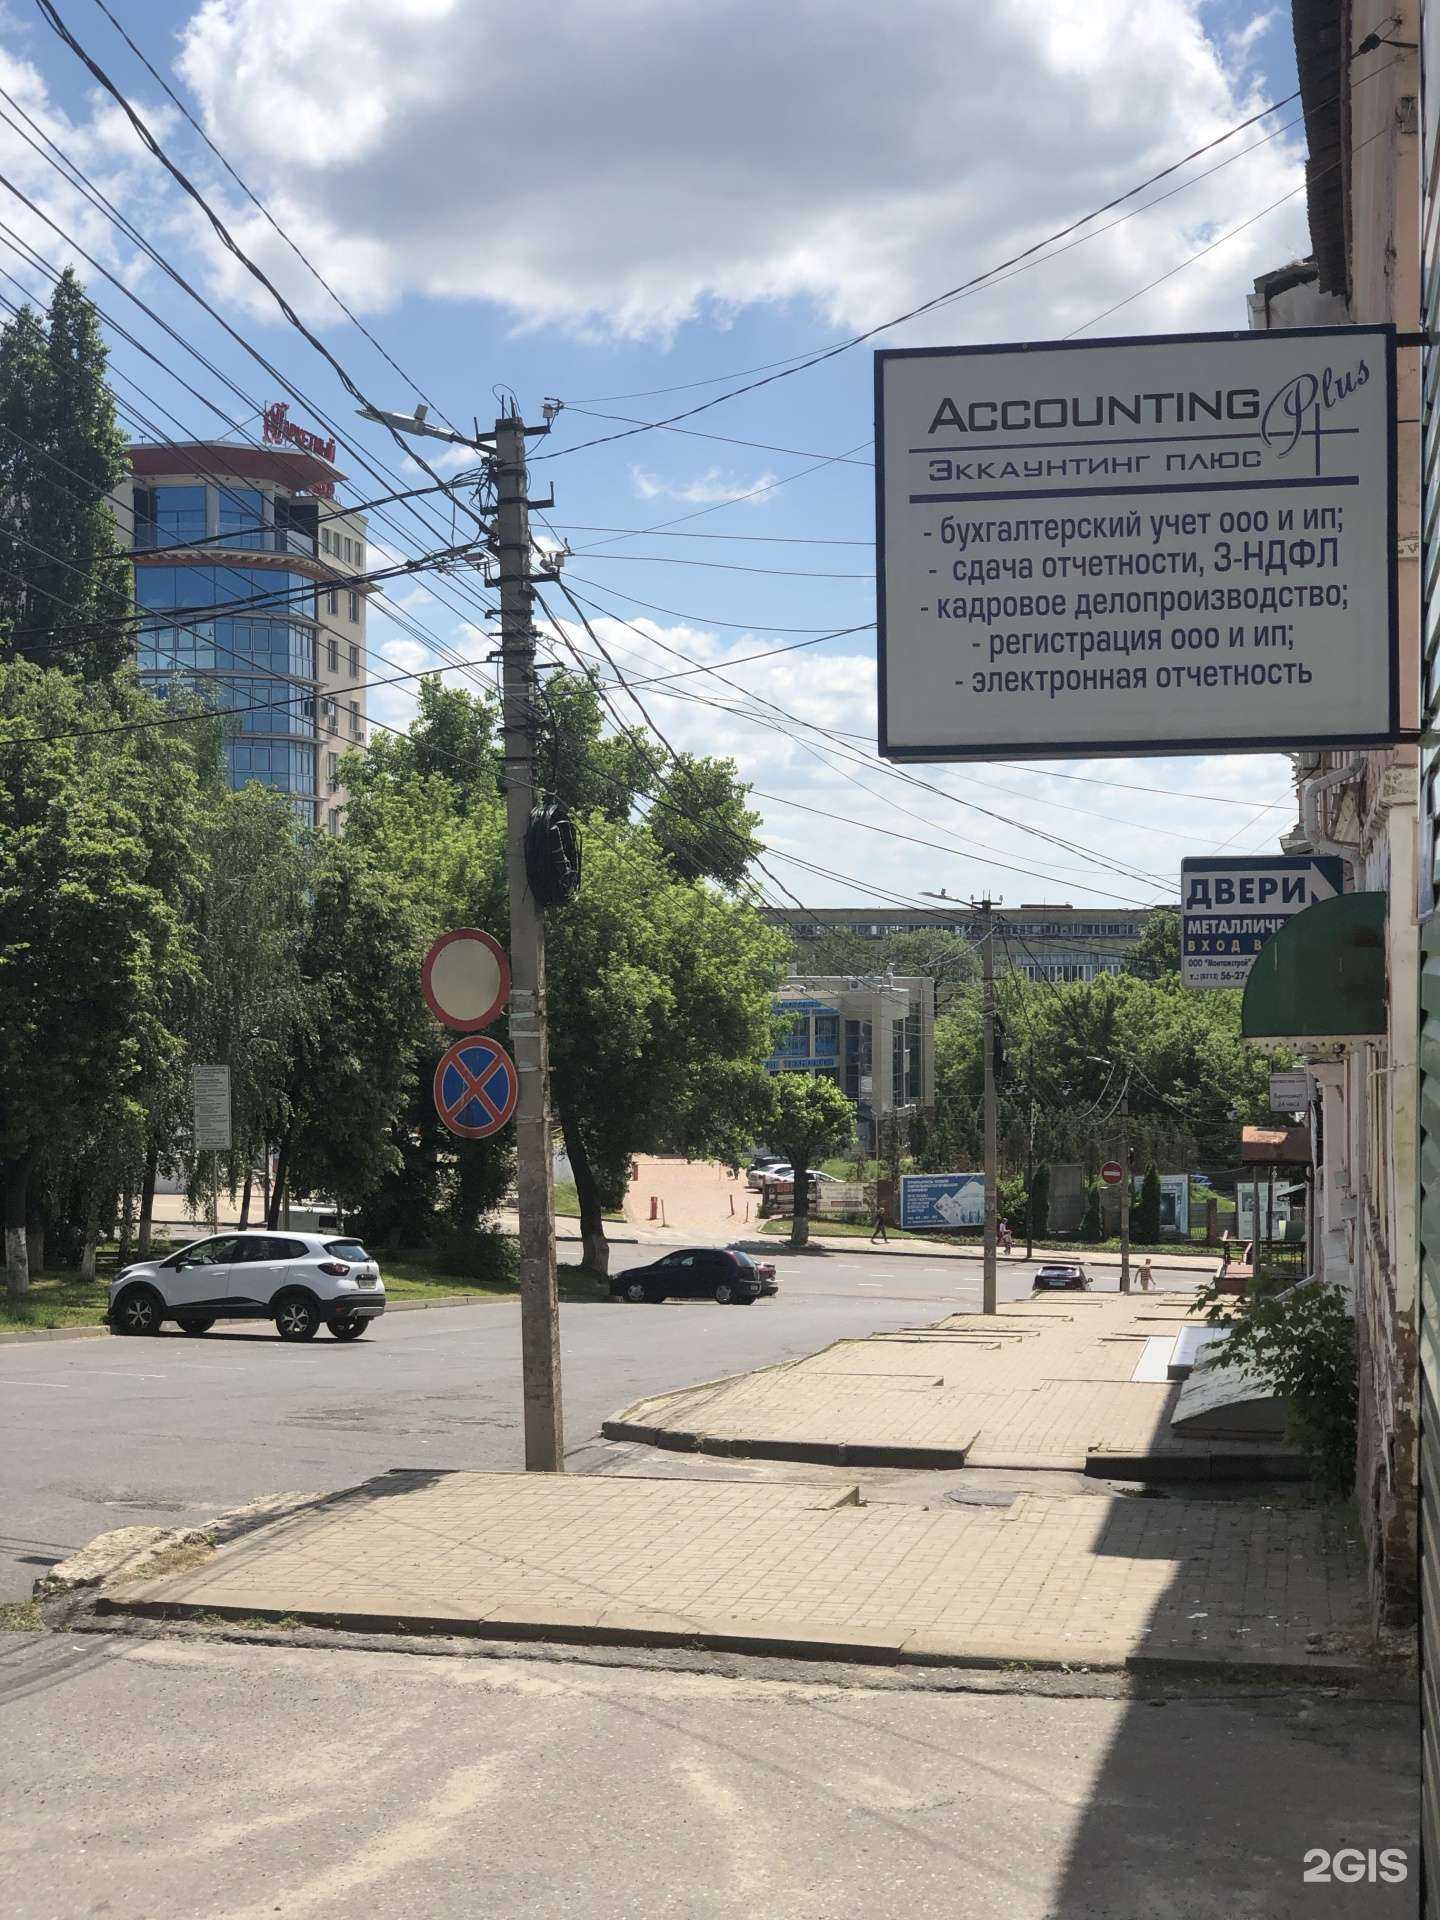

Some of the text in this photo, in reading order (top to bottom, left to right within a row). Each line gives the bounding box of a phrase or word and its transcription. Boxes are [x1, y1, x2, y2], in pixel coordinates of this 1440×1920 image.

[1262, 359, 1370, 456] Plus
[1166, 450, 1262, 471] ПЛЮС
[940, 510, 1141, 551] бухгалтерский
[1150, 512, 1211, 544] учет
[1278, 509, 1294, 531] и
[953, 557, 1033, 586] сдача
[1042, 552, 1205, 579] отчетности,
[1214, 537, 1338, 576] 3-НДФЛ
[937, 592, 1067, 626] кадровое
[1074, 584, 1348, 620] делопроизводство;
[989, 629, 1162, 663] регистрация
[1229, 626, 1244, 647] и
[972, 666, 1147, 699] электронная
[1156, 662, 1313, 688] отчетность
[1186, 877, 1306, 910] ДВЕРИ
[1187, 918, 1286, 934] МЕТАЛЛИЧЕ
[1187, 939, 1241, 953] ВХОД
[1220, 971, 1249, 981] 56-27-
